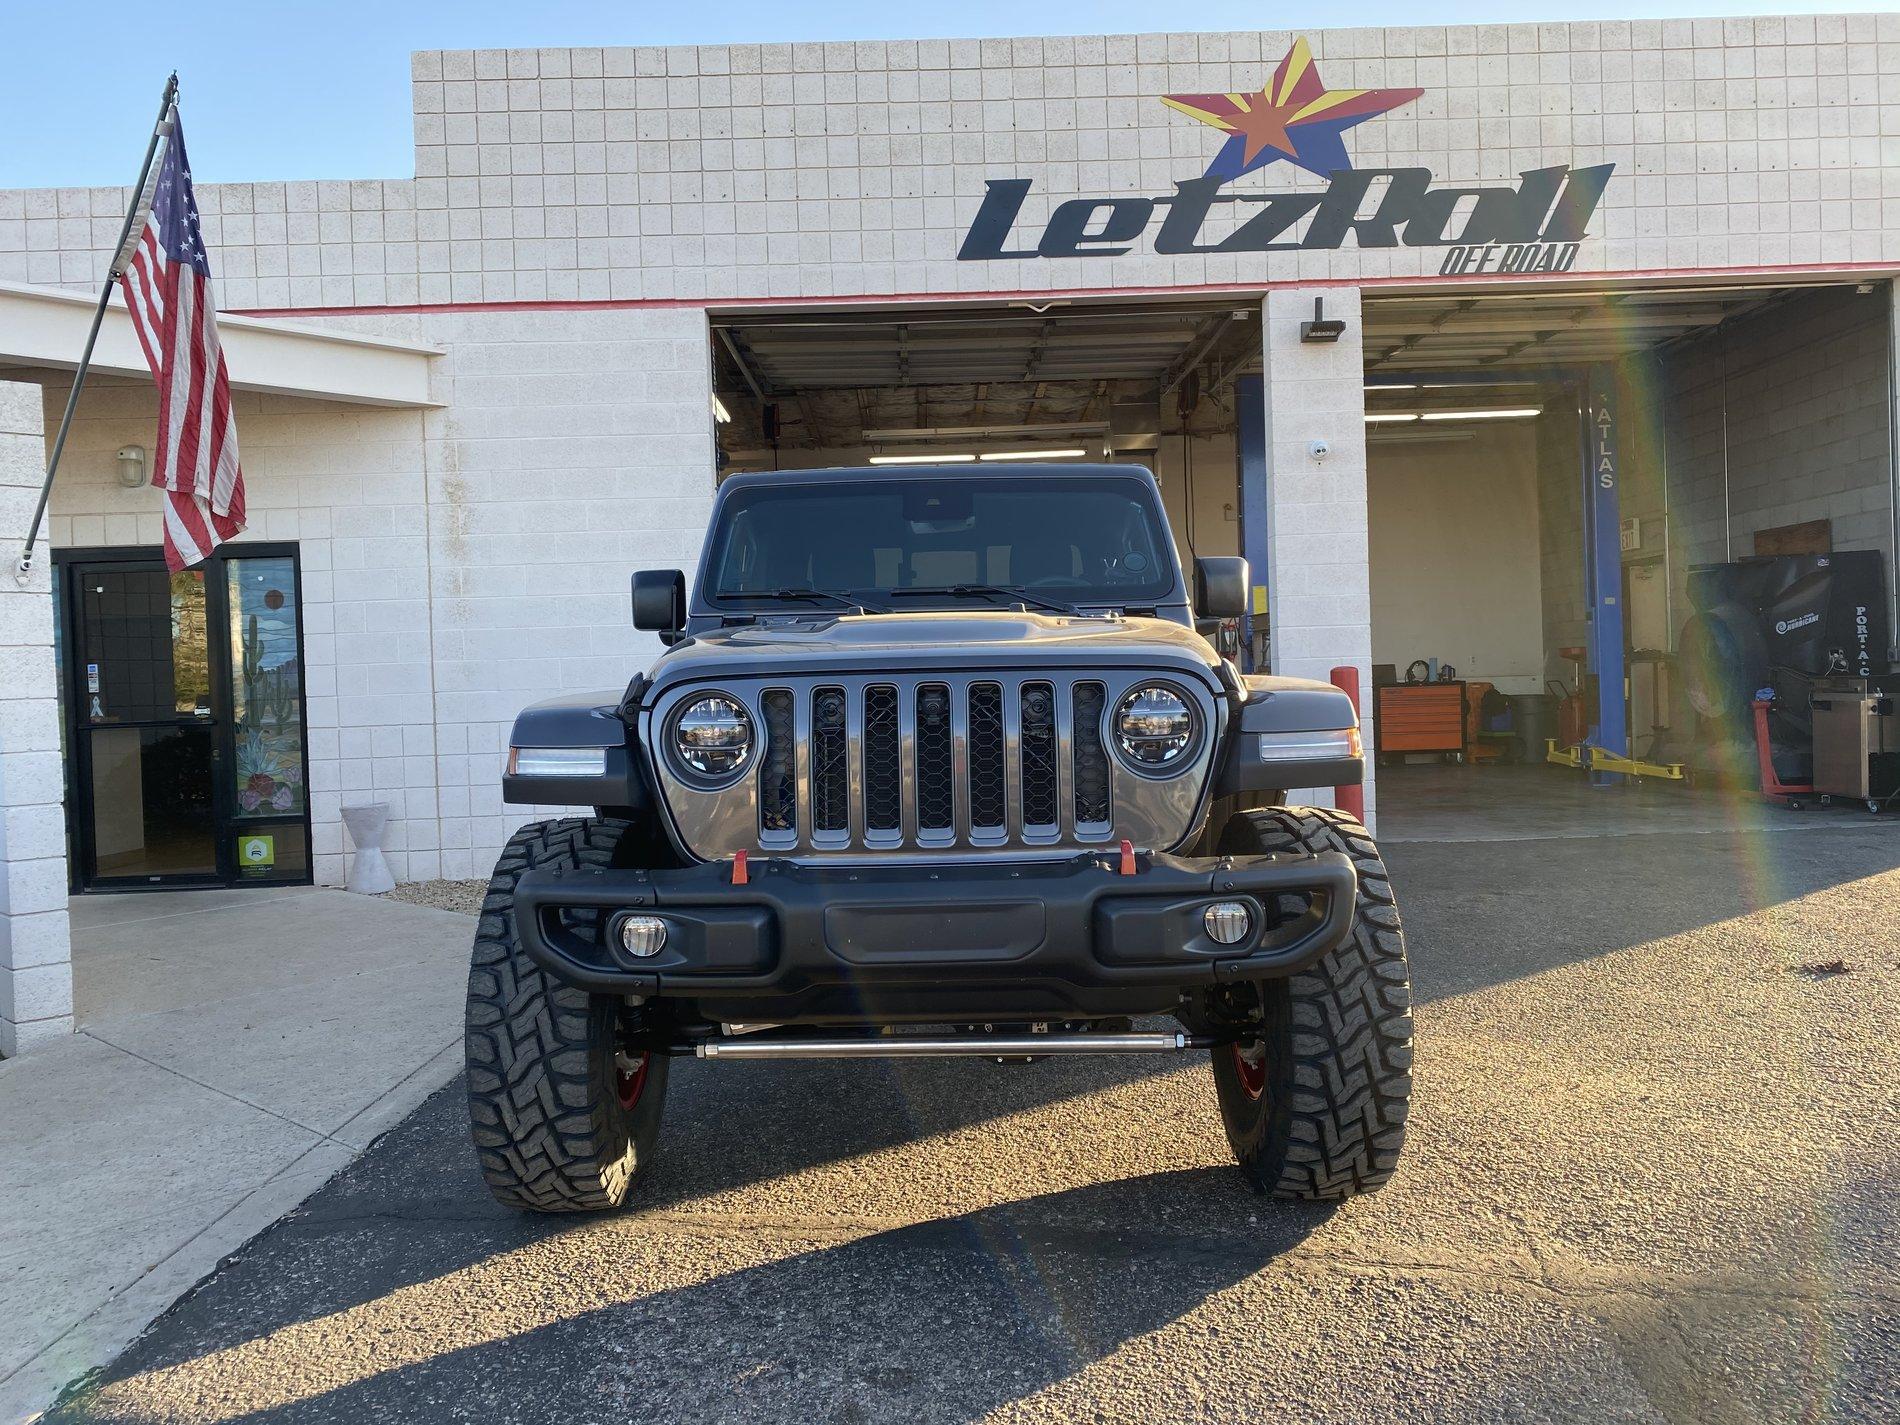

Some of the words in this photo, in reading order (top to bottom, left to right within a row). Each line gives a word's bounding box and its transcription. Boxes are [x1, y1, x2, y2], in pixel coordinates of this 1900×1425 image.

[957, 163, 1616, 260] LetzRoll
[1439, 245, 1501, 275] OFF
[1497, 243, 1580, 273] ROAD
[1597, 408, 1614, 489] ATLAS
